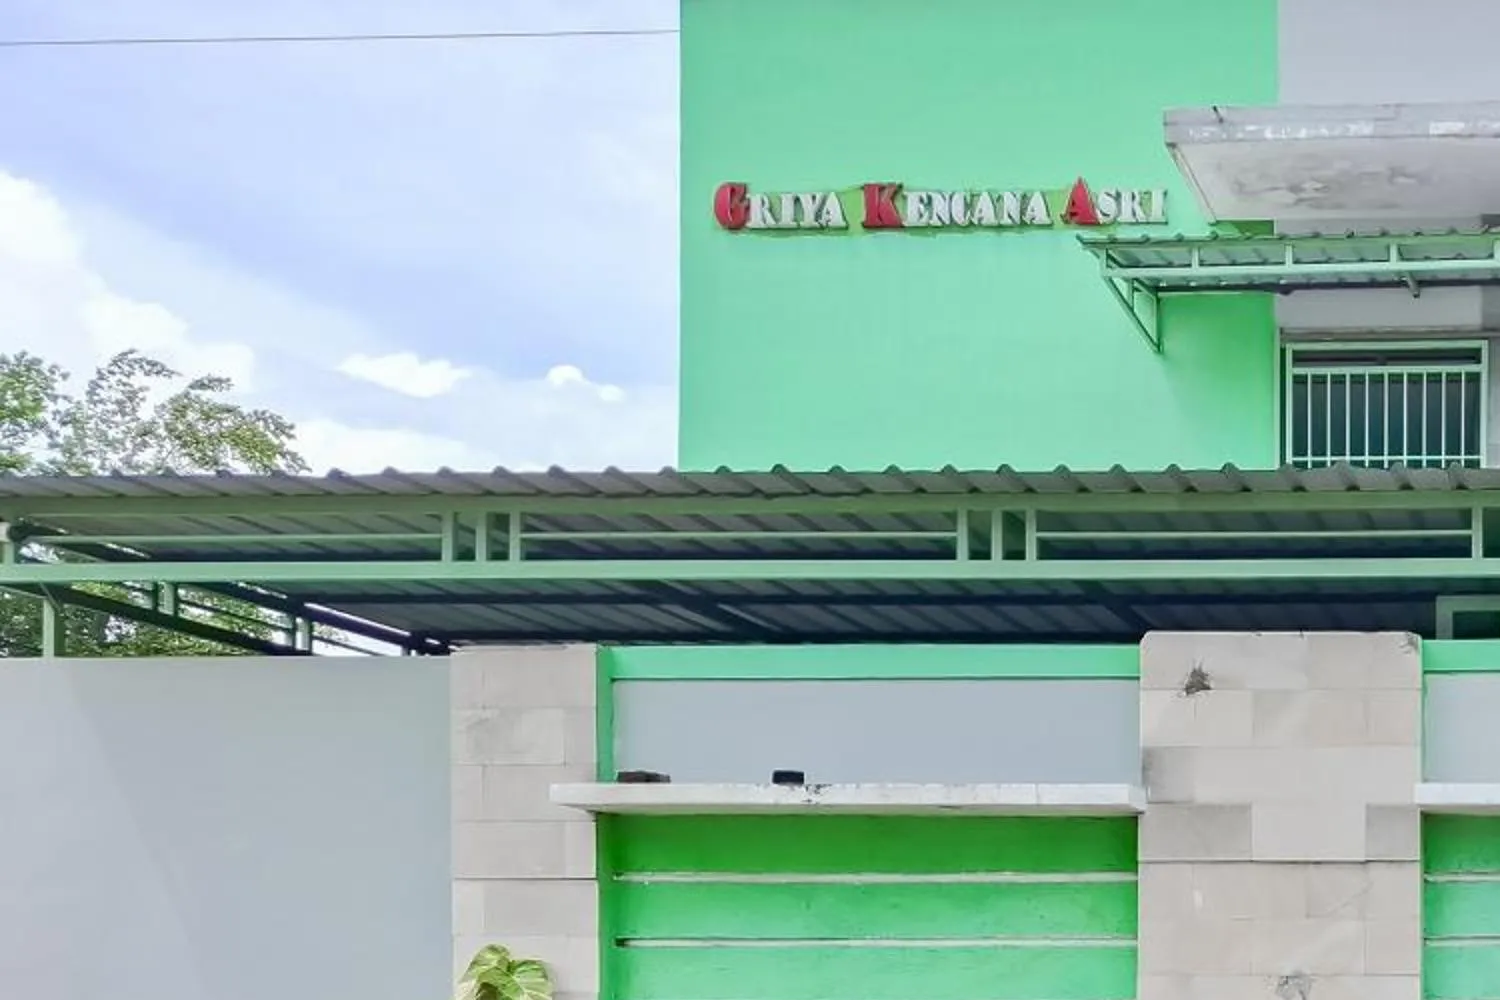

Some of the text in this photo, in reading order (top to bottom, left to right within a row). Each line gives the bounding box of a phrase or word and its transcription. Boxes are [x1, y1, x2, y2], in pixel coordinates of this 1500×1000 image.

[714, 175, 1168, 231] GRIYA KENCANA ASRI
